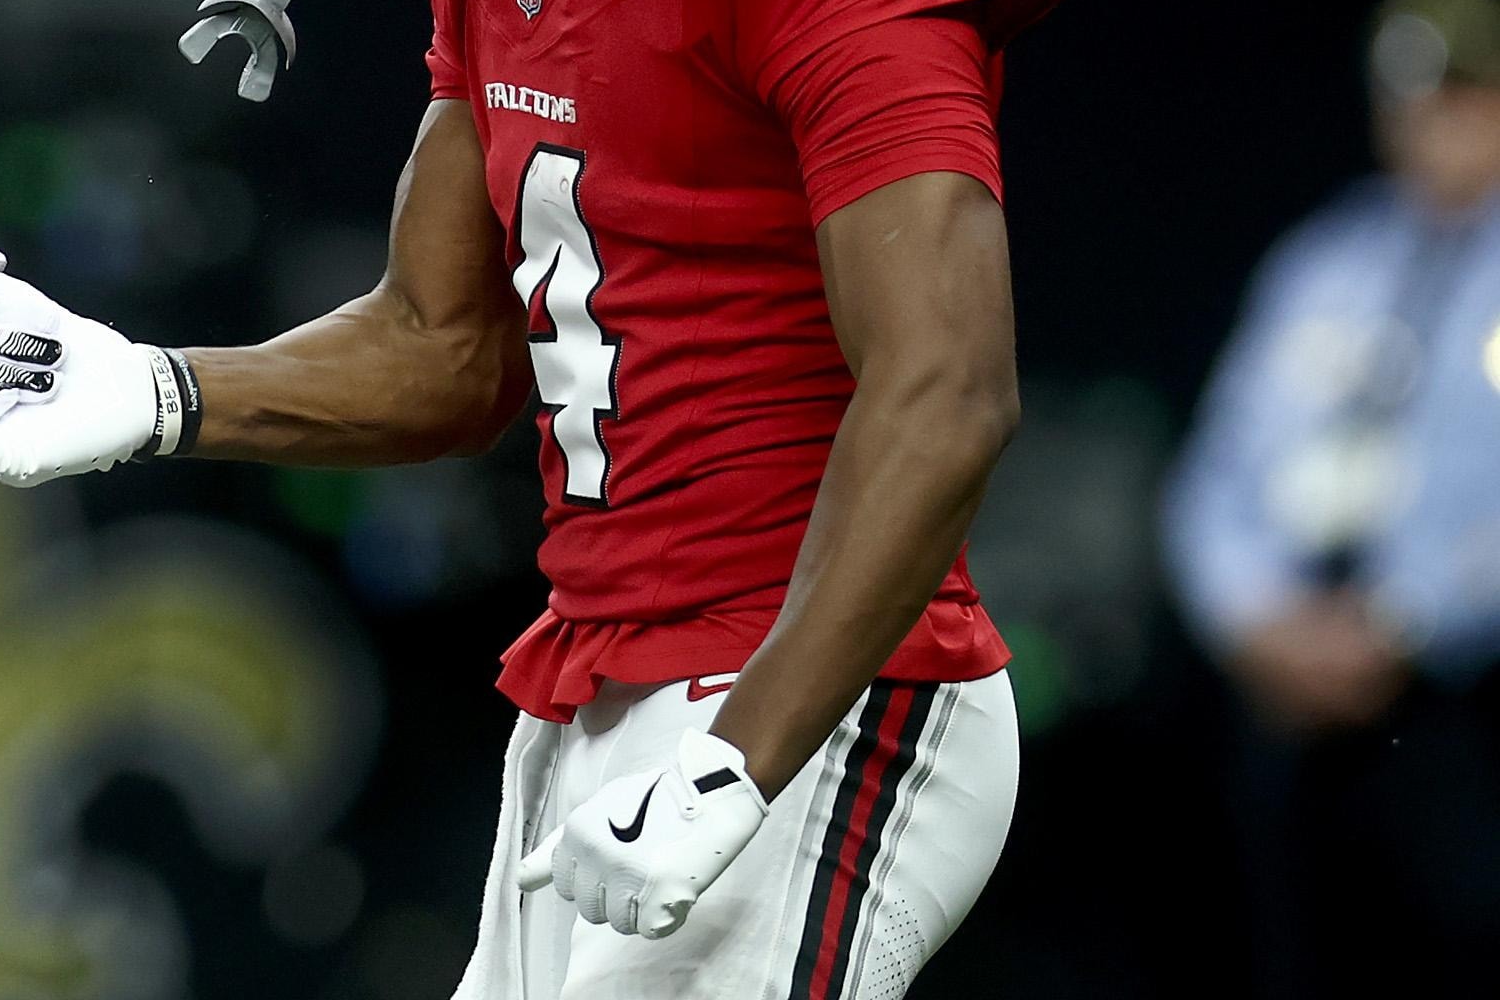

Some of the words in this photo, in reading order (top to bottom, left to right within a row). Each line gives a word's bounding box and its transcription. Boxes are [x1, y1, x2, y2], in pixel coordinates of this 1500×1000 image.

[485, 82, 576, 124] FALCONS
[510, 140, 623, 508] 4
[164, 389, 179, 414] BE
